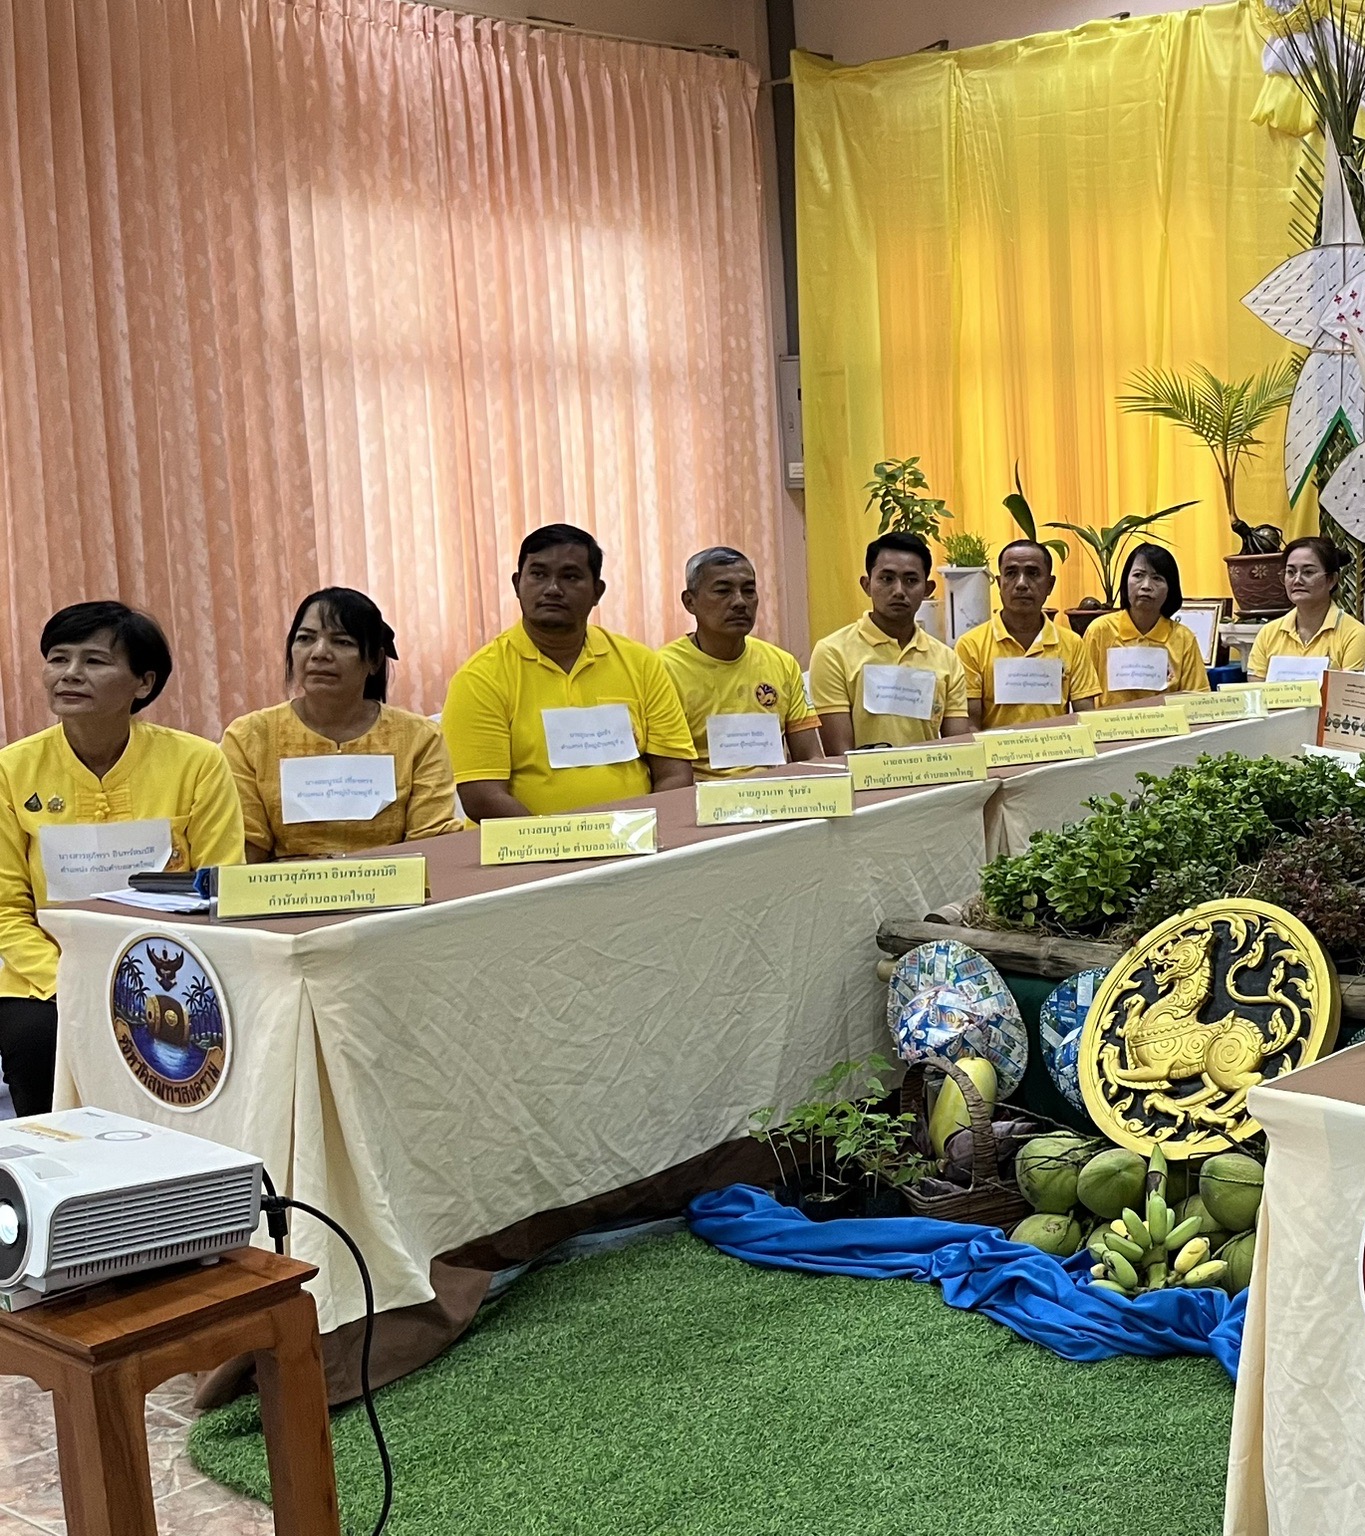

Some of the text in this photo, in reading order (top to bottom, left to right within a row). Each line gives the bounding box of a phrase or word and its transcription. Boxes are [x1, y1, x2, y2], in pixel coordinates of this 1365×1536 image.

[497, 842, 560, 861] ผู้ใหญ่บ้านหมู่
[248, 864, 397, 884] นางสาวสุภัทรา อินทร์สมบัติ
[268, 888, 376, 907] กำนันตำบลลาดใหญ่
